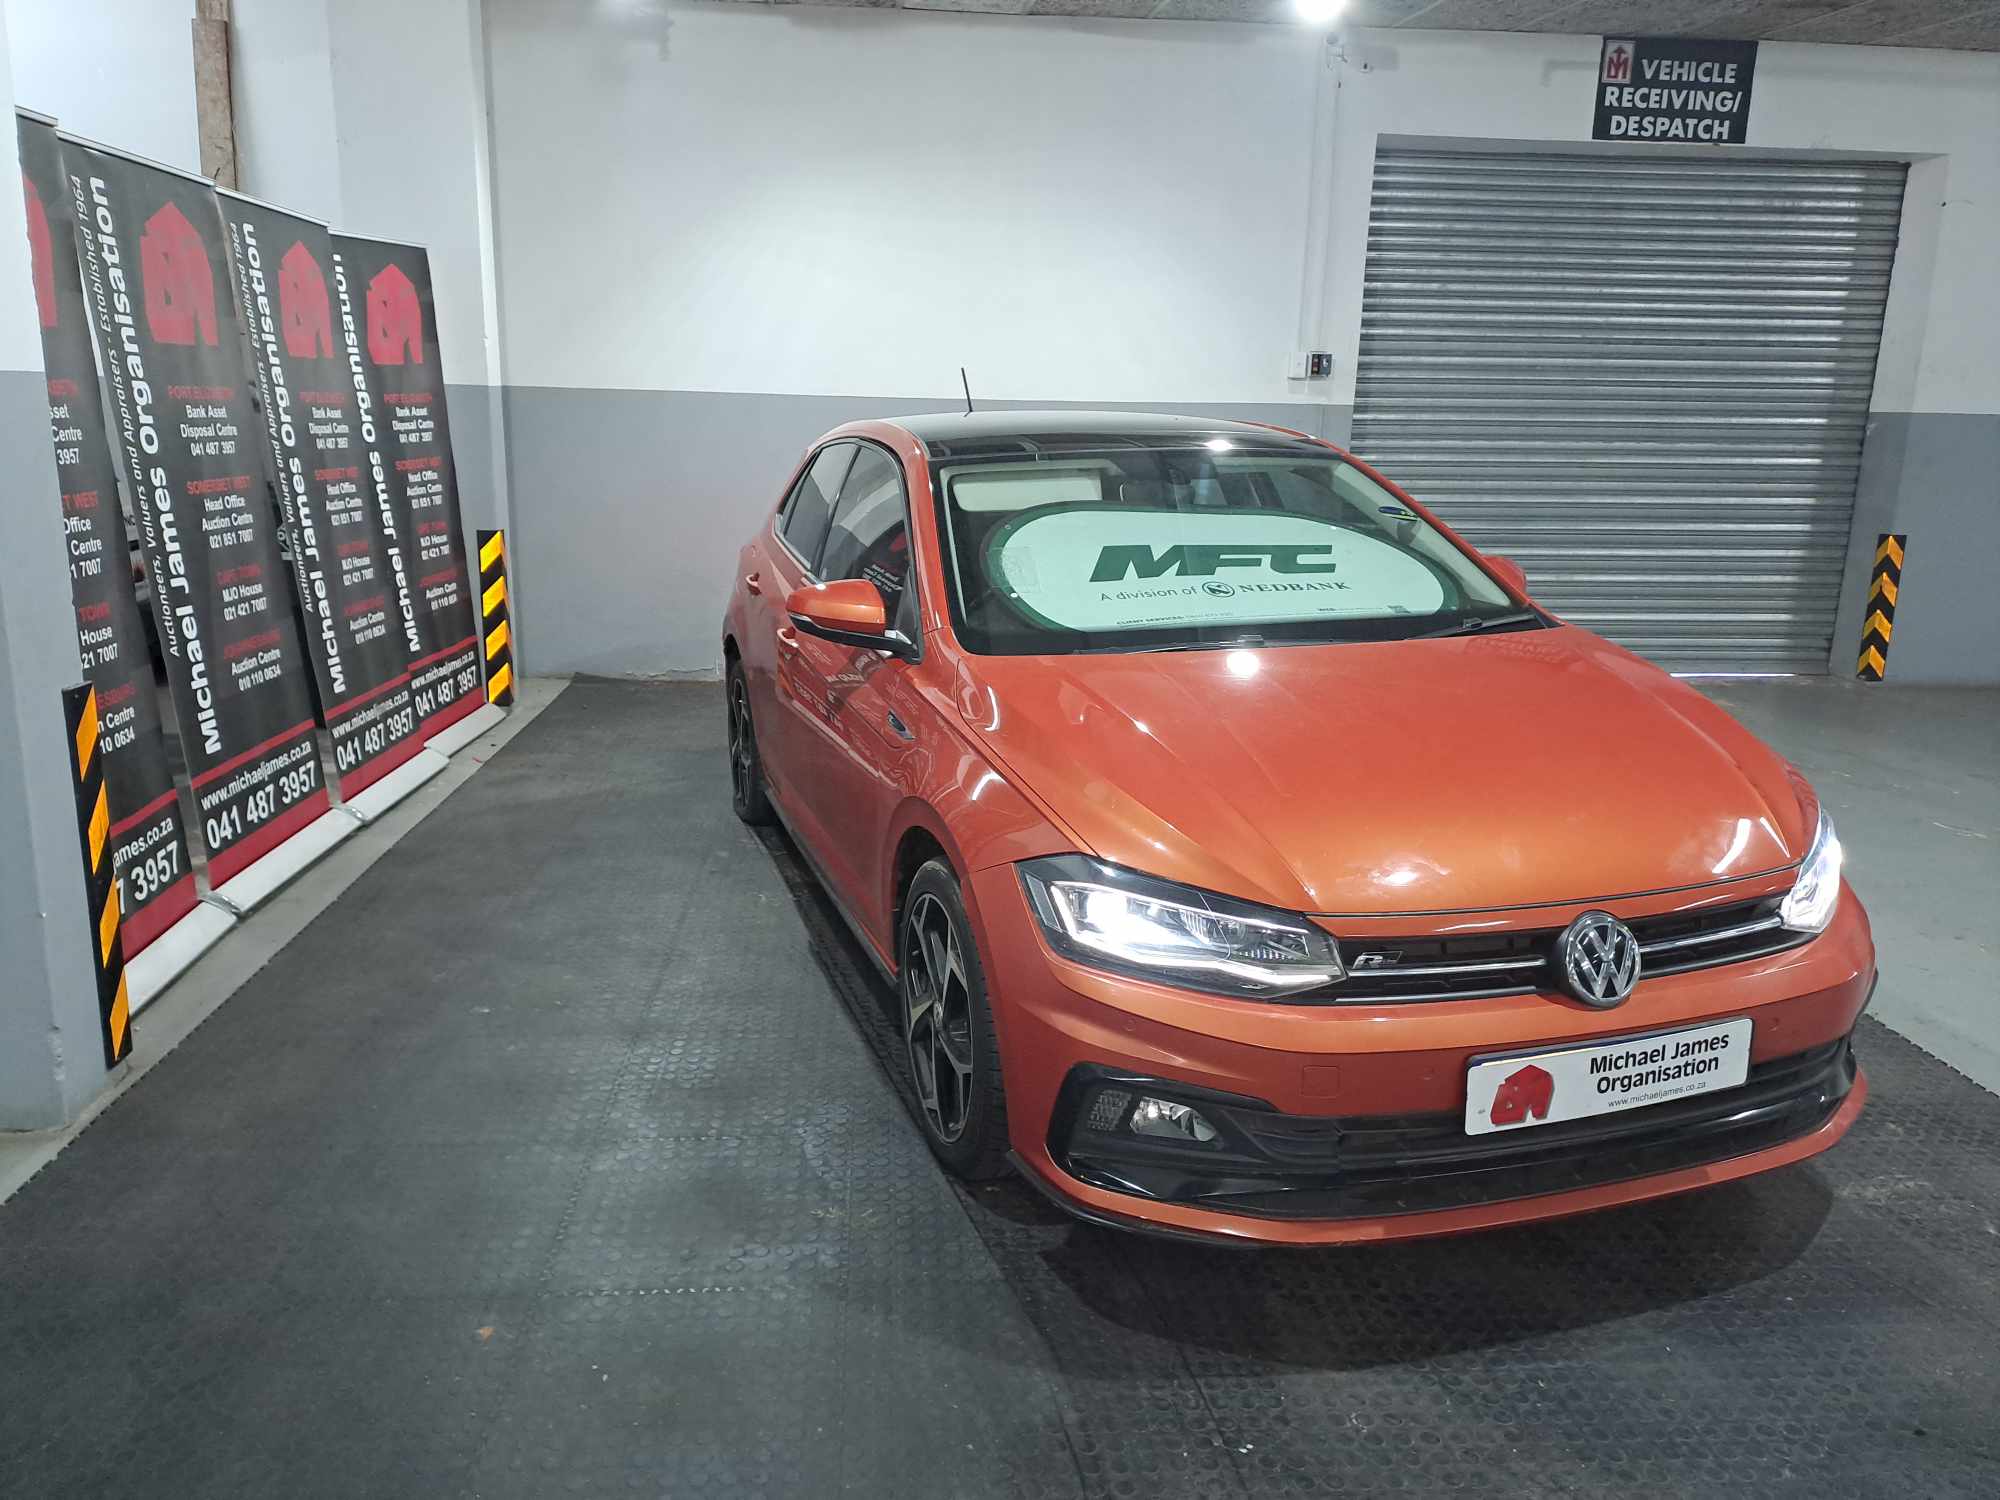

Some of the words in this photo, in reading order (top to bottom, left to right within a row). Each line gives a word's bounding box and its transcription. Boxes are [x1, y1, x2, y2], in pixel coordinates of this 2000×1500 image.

[1642, 59, 1737, 84] VEHICLE
[1604, 86, 1743, 112] RECEIVING/
[1610, 115, 1730, 140] DESPATCH
[70, 174, 89, 222] 1964
[80, 226, 112, 333] Established
[90, 176, 159, 454] Organisation
[243, 222, 295, 447] Organisation
[108, 348, 135, 442] Appraisers
[257, 361, 278, 437] Appraisers
[57, 448, 80, 465] 3957
[126, 446, 142, 480] and
[271, 439, 284, 468] and
[137, 484, 157, 548] Valuers
[279, 471, 295, 523] Valuers
[289, 457, 320, 561] James
[369, 451, 397, 540] James
[150, 466, 189, 594] James
[202, 515, 230, 531] Auction
[70, 538, 102, 556] Centre
[79, 558, 102, 578] 7007
[1089, 545, 1336, 582] MFC
[239, 583, 263, 597] House
[387, 547, 421, 653] Michael
[1101, 592, 1112, 600] A
[1117, 586, 1178, 600] division
[1183, 585, 1197, 595] of
[1239, 582, 1352, 593] NEDBANK
[80, 626, 113, 646] House
[309, 570, 346, 694] Michael
[80, 651, 95, 670] 21
[97, 643, 118, 664] 7007
[176, 605, 222, 755] Michael
[414, 688, 437, 717] 041
[437, 678, 455, 704] 487
[456, 665, 478, 694] 3957
[106, 705, 135, 729] Centre
[114, 725, 135, 747] 0634
[336, 737, 363, 771] 041
[364, 723, 386, 753] 487
[387, 707, 414, 741] 3957
[201, 741, 312, 810] www.michaeljames.co.za
[206, 805, 242, 849] 041
[246, 784, 275, 823] 487
[279, 760, 316, 804] 3957
[131, 840, 178, 901] 3957
[1590, 1044, 1666, 1074] Michael
[1671, 1034, 1729, 1060] James
[1597, 1057, 1719, 1094] Organisation
[1608, 1081, 1706, 1107] www.michaeljames.co.za
